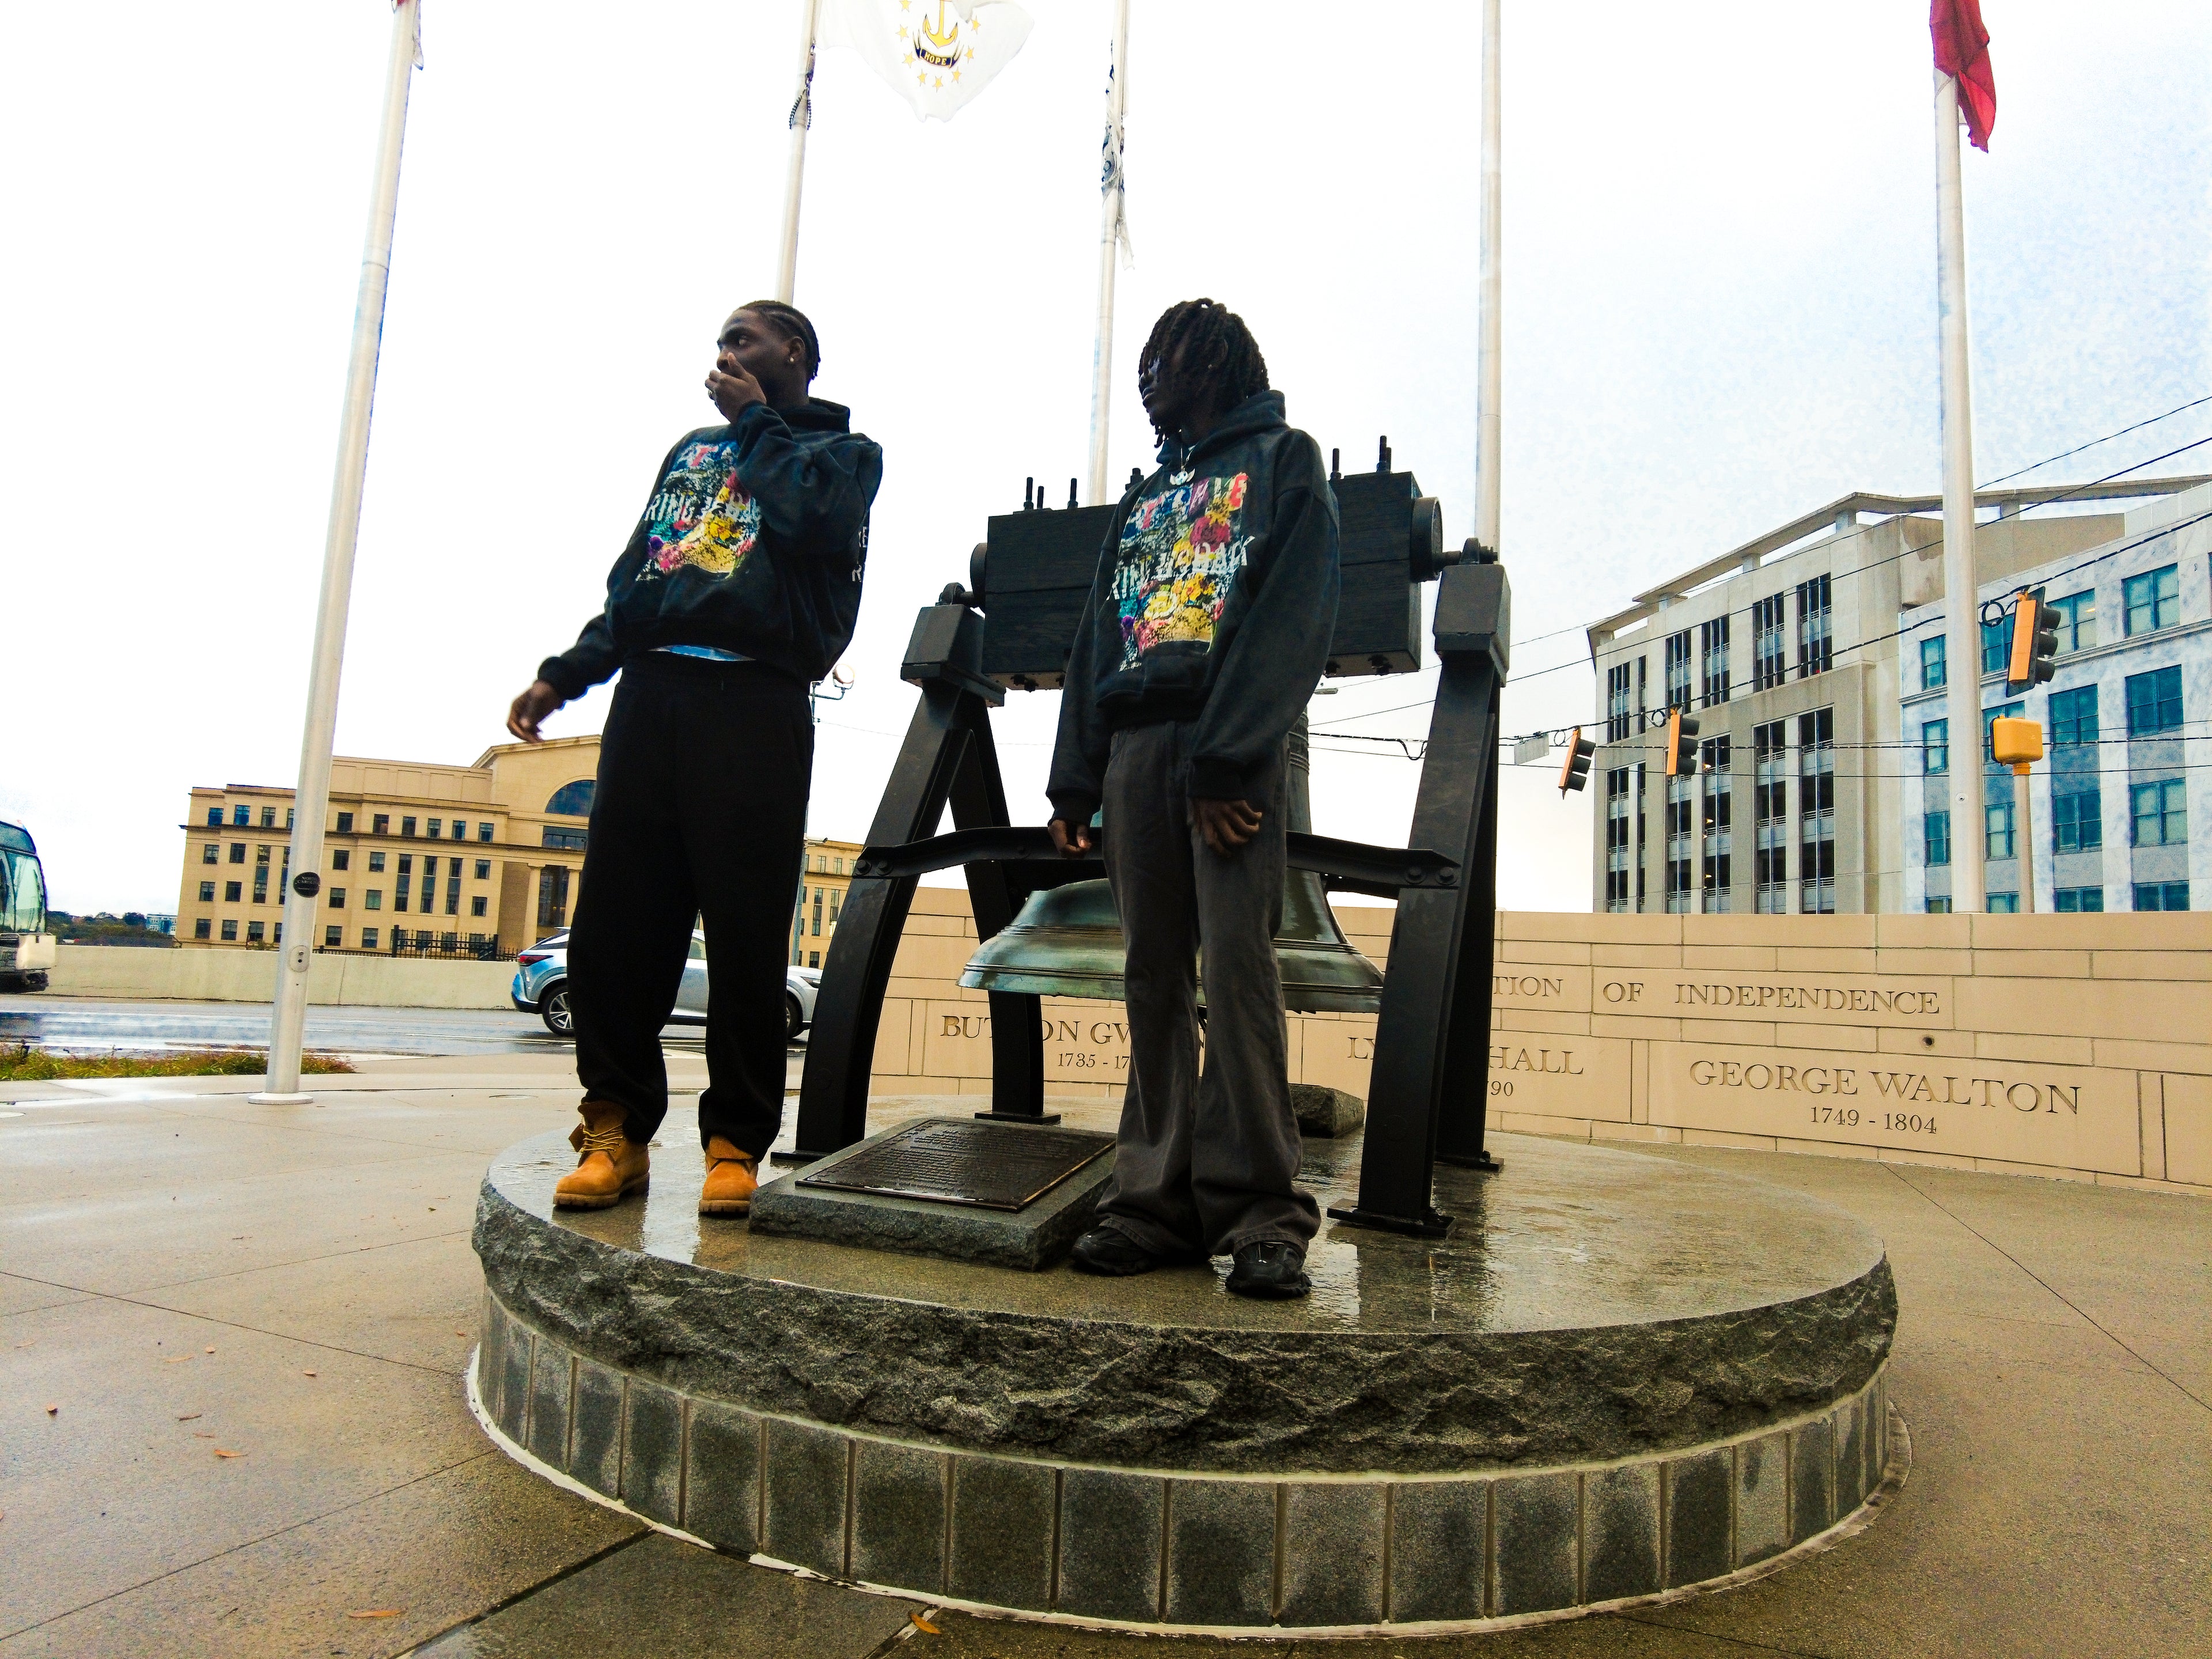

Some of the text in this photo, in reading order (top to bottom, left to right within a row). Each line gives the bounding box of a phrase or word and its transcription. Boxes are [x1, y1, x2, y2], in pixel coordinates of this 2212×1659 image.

[924, 52, 947, 66] HOPE
[1493, 976, 1940, 1014] TION OF INDEPENDENCE
[1058, 1052, 1096, 1069] 1735
[1689, 1060, 2082, 1116] GEORGE WALTON
[1810, 1106, 1860, 1126] 1749
[1883, 1112, 1937, 1134] 1804
